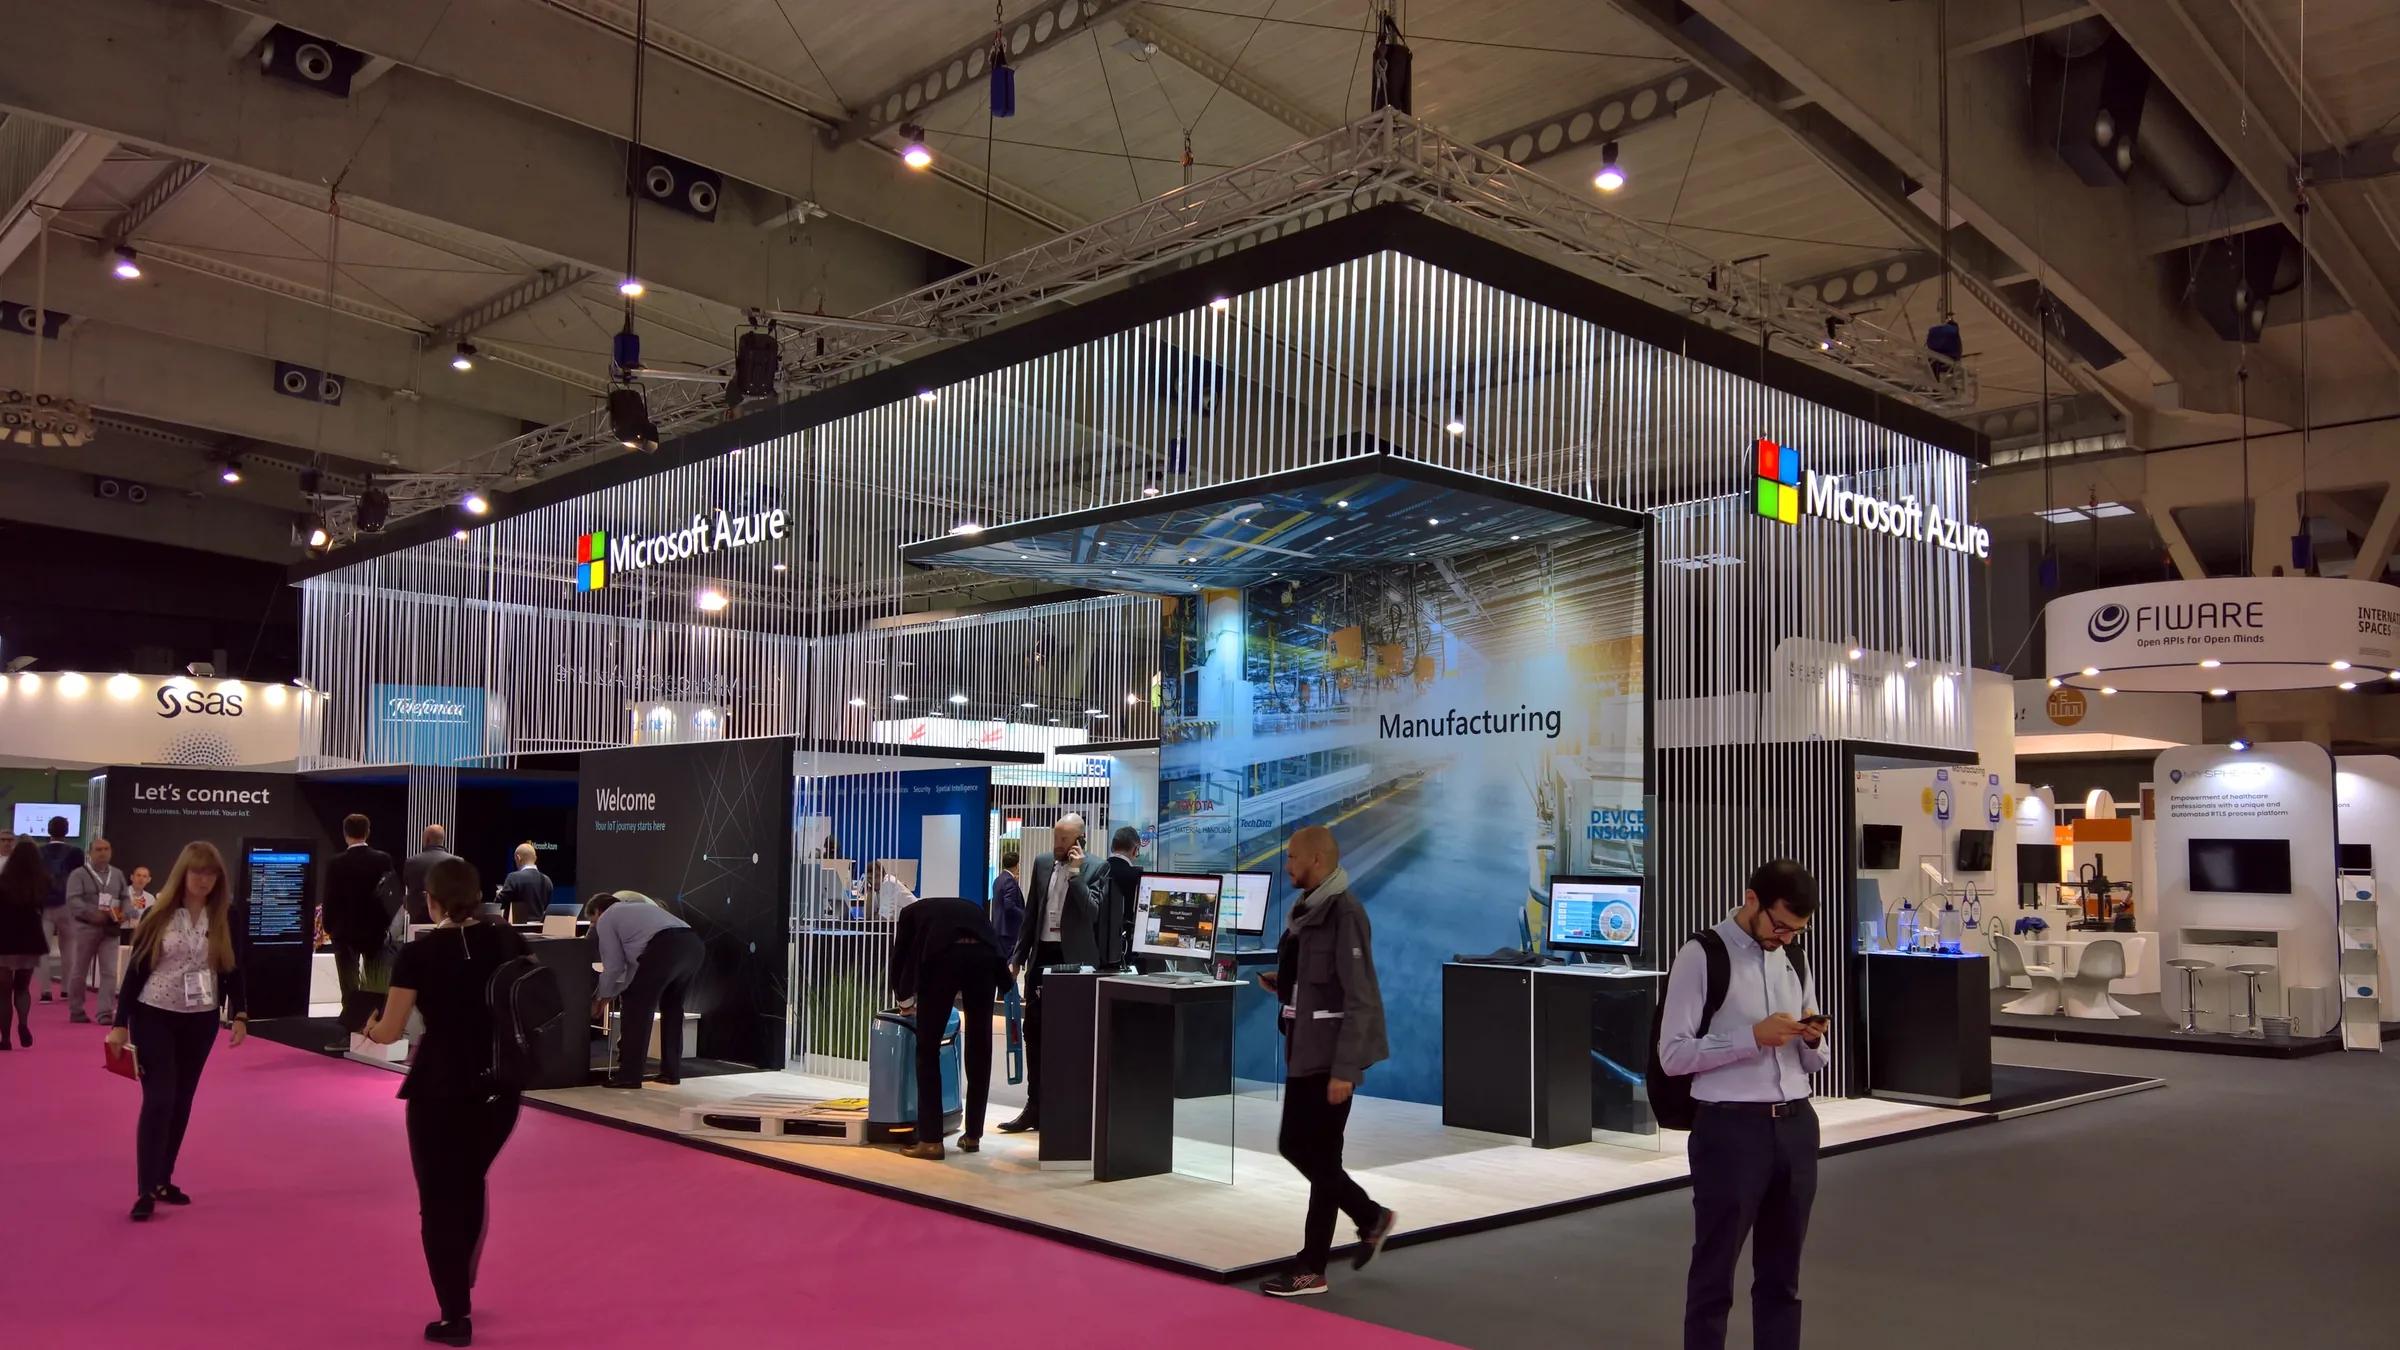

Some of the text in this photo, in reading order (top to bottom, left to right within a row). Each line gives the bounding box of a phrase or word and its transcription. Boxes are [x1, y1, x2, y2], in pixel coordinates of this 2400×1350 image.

[1807, 470, 1990, 559] Microsoft Azure
[611, 508, 786, 574] Microsoft Azure
[2137, 602, 2263, 632] FIWARE
[2358, 620, 2392, 636] SPACES
[2137, 634, 2265, 648] Open APIs for Open Minds
[1380, 704, 1561, 739] Manufacturing
[187, 788, 270, 804] connect
[596, 786, 656, 811] Welcome
[2170, 794, 2220, 802] Empowerment
[182, 808, 198, 816] Your
[222, 809, 238, 817] Your
[1175, 800, 1214, 811] TOYOTA
[2170, 802, 2217, 810] professionals
[2240, 802, 2265, 810] unique
[1591, 810, 1647, 824] DEVICE
[2171, 810, 2210, 818] automated
[2228, 811, 2255, 819] process
[2257, 810, 2289, 818] platform
[595, 820, 606, 831] Your
[616, 820, 637, 833] journey
[637, 821, 652, 831] starts
[653, 820, 665, 831] here
